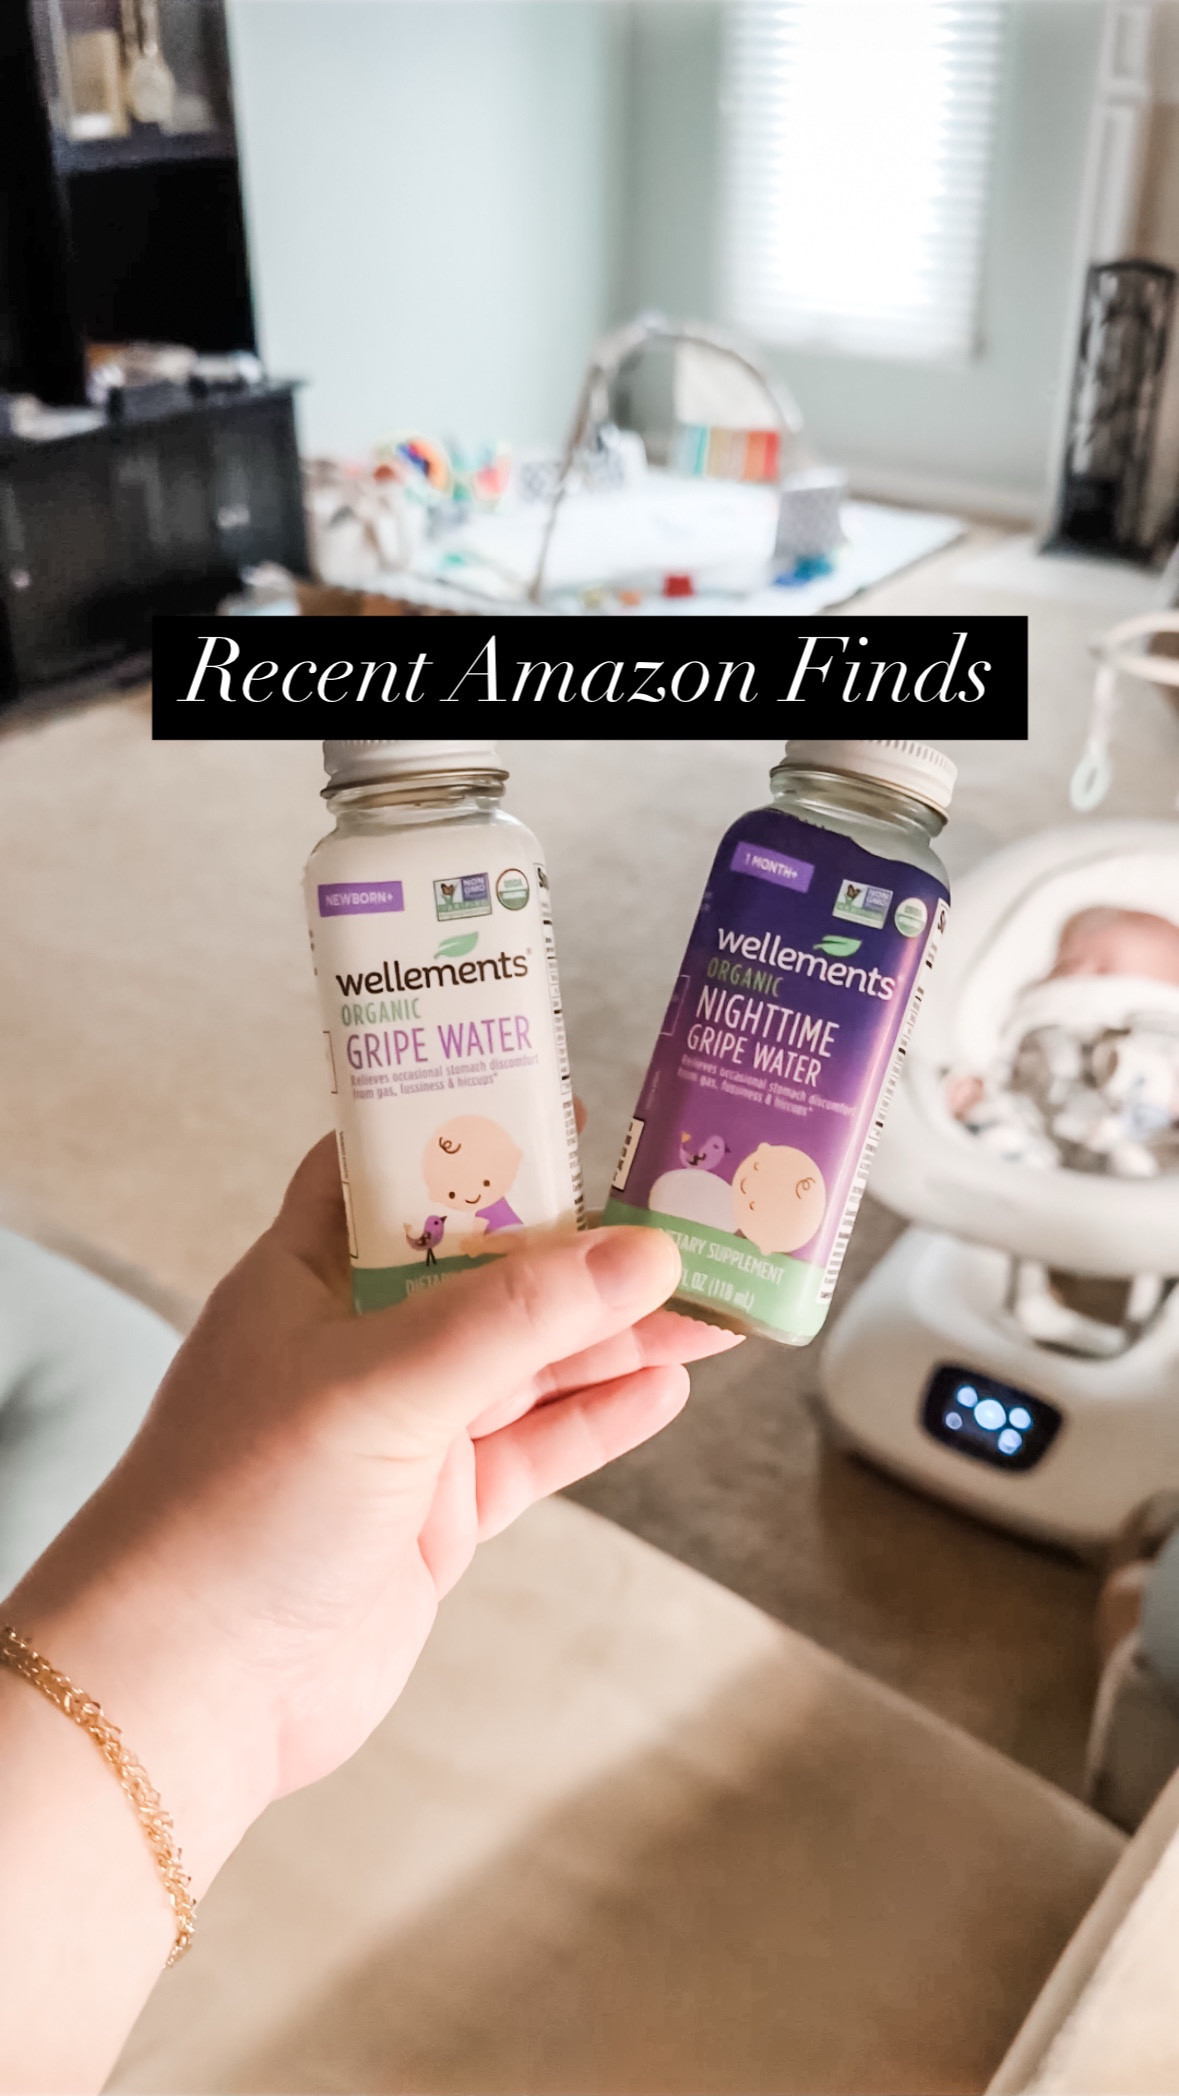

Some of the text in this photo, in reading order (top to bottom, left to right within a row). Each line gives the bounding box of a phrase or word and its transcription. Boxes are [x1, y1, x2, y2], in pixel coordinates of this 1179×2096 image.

[746, 853, 751, 865] 1
[325, 891, 394, 907] NEWBORN+
[336, 952, 528, 997] wellements
[707, 957, 784, 998] ORGANIC
[718, 928, 897, 1001] wellements
[342, 998, 421, 1027] ORGANIC
[696, 984, 840, 1058] NIGHTTIME
[347, 1015, 532, 1070] GRIPE WATER
[687, 1023, 822, 1088] GRIPE WATER
[393, 1066, 443, 1082] occasional
[446, 1061, 487, 1076] stomach
[490, 1054, 539, 1071] discomfort
[377, 1086, 397, 1100] gas,
[670, 1229, 708, 1255] TARY
[707, 1242, 786, 1286] SUPPLEMENT
